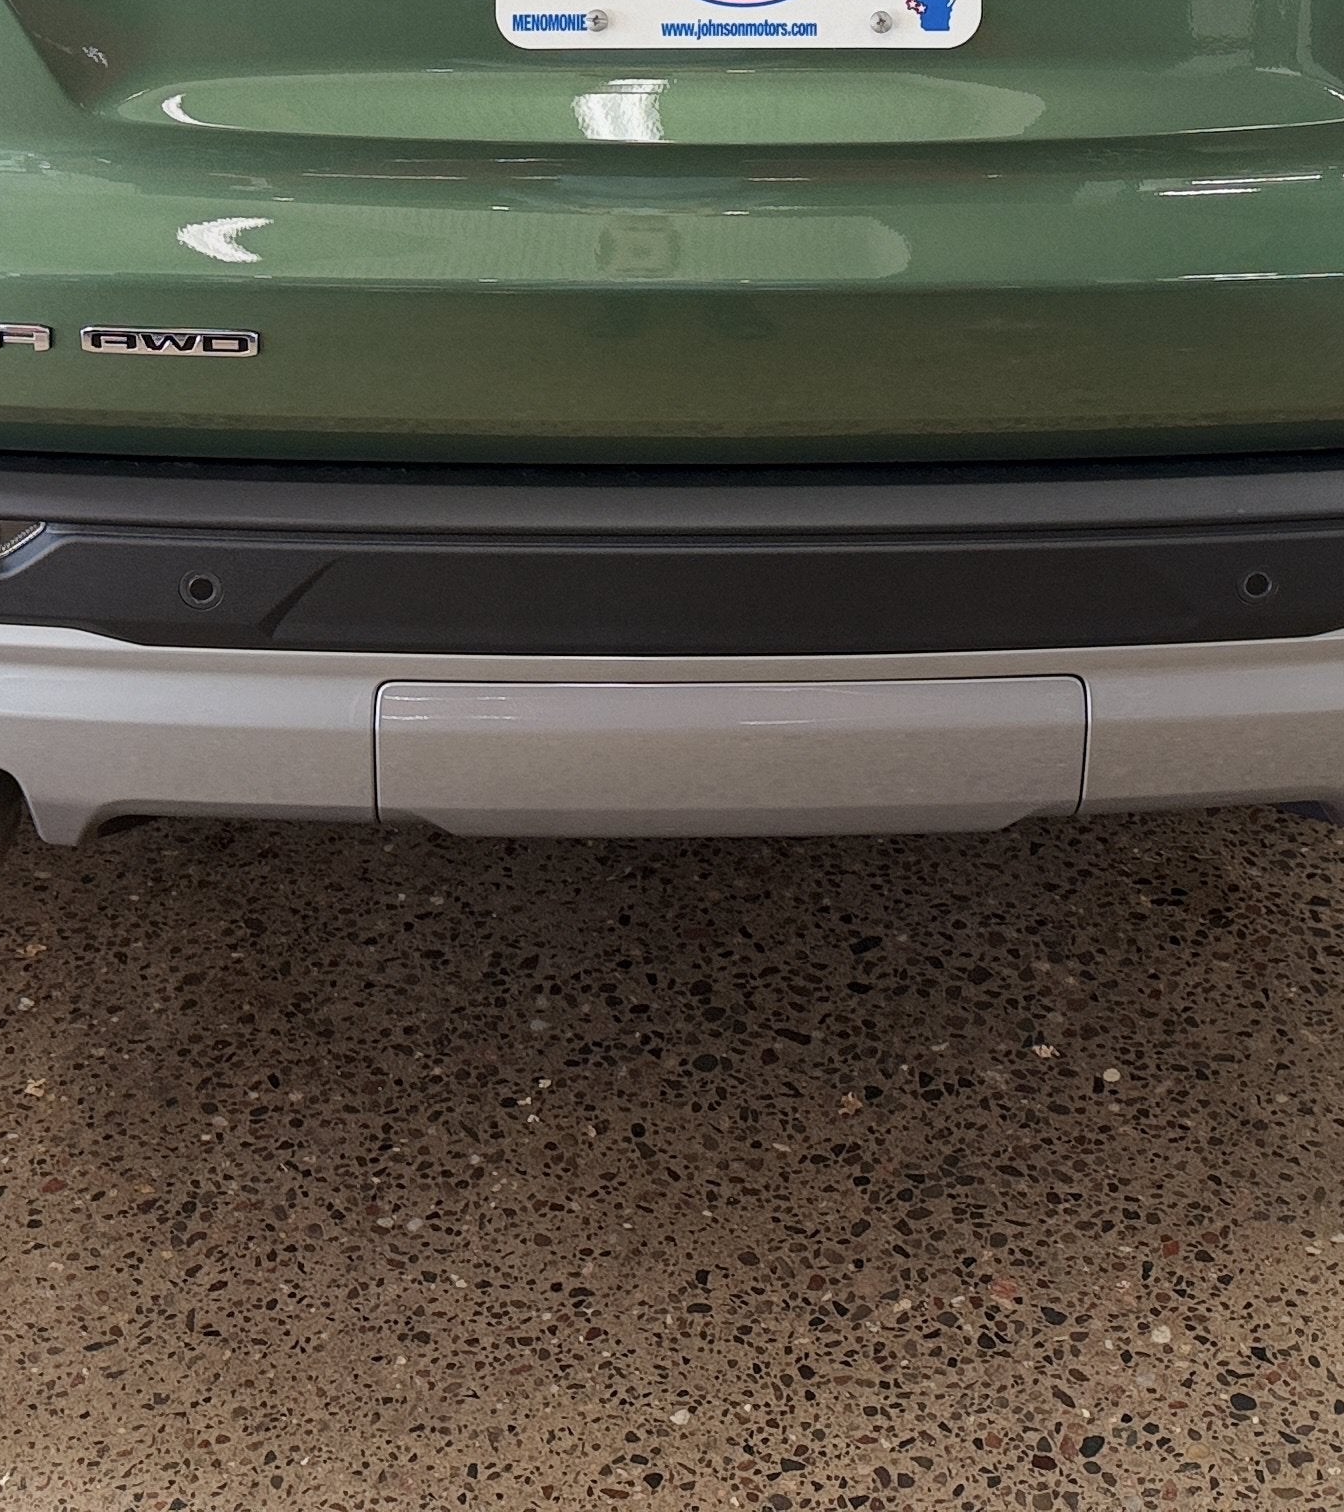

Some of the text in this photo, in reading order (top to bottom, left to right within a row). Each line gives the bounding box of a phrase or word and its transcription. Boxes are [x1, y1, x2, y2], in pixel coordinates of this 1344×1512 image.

[512, 14, 588, 32] MENOMONIE
[661, 19, 818, 40] www.johnsonmotors.com
[89, 330, 252, 355] AWD
